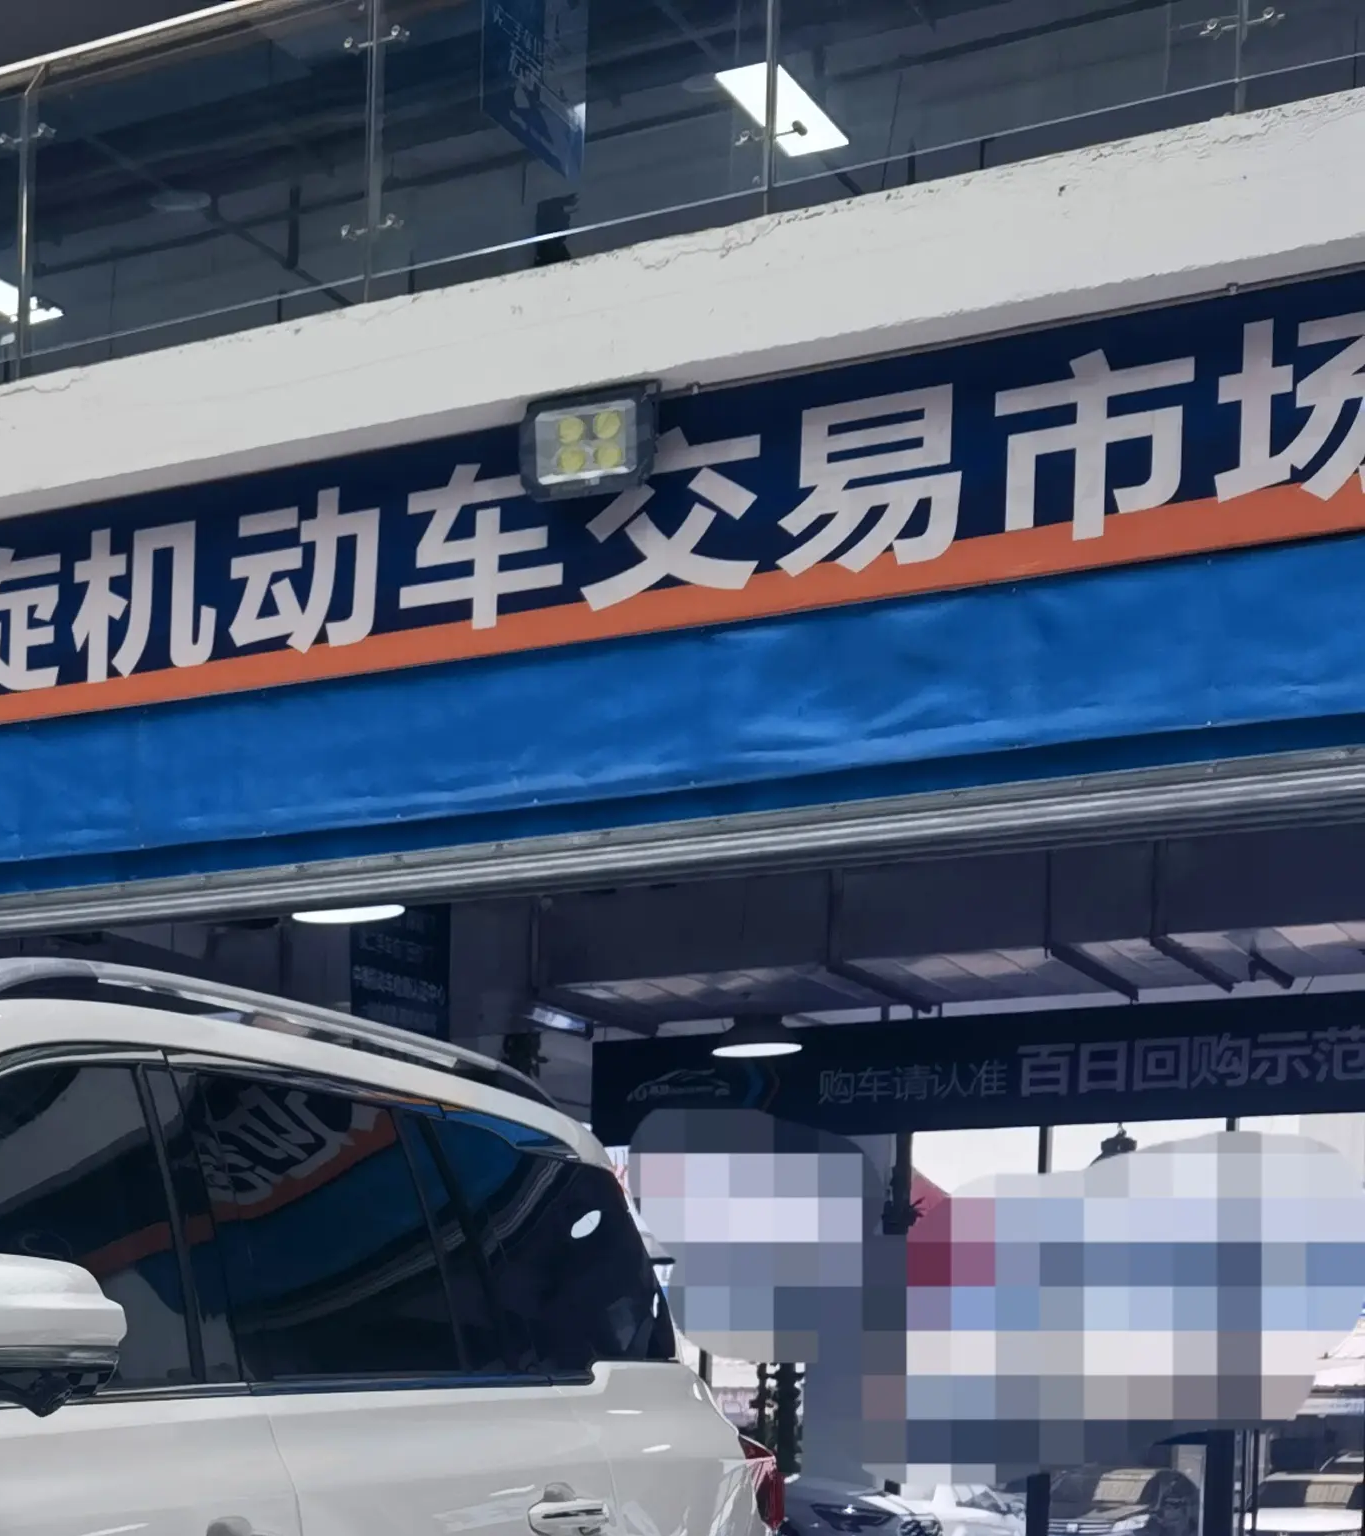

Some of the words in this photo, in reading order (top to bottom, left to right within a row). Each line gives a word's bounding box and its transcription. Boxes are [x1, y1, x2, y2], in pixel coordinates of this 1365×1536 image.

[817, 1058, 1008, 1105] 购车请认准
[1017, 1025, 1365, 1098] 百日回购示范
